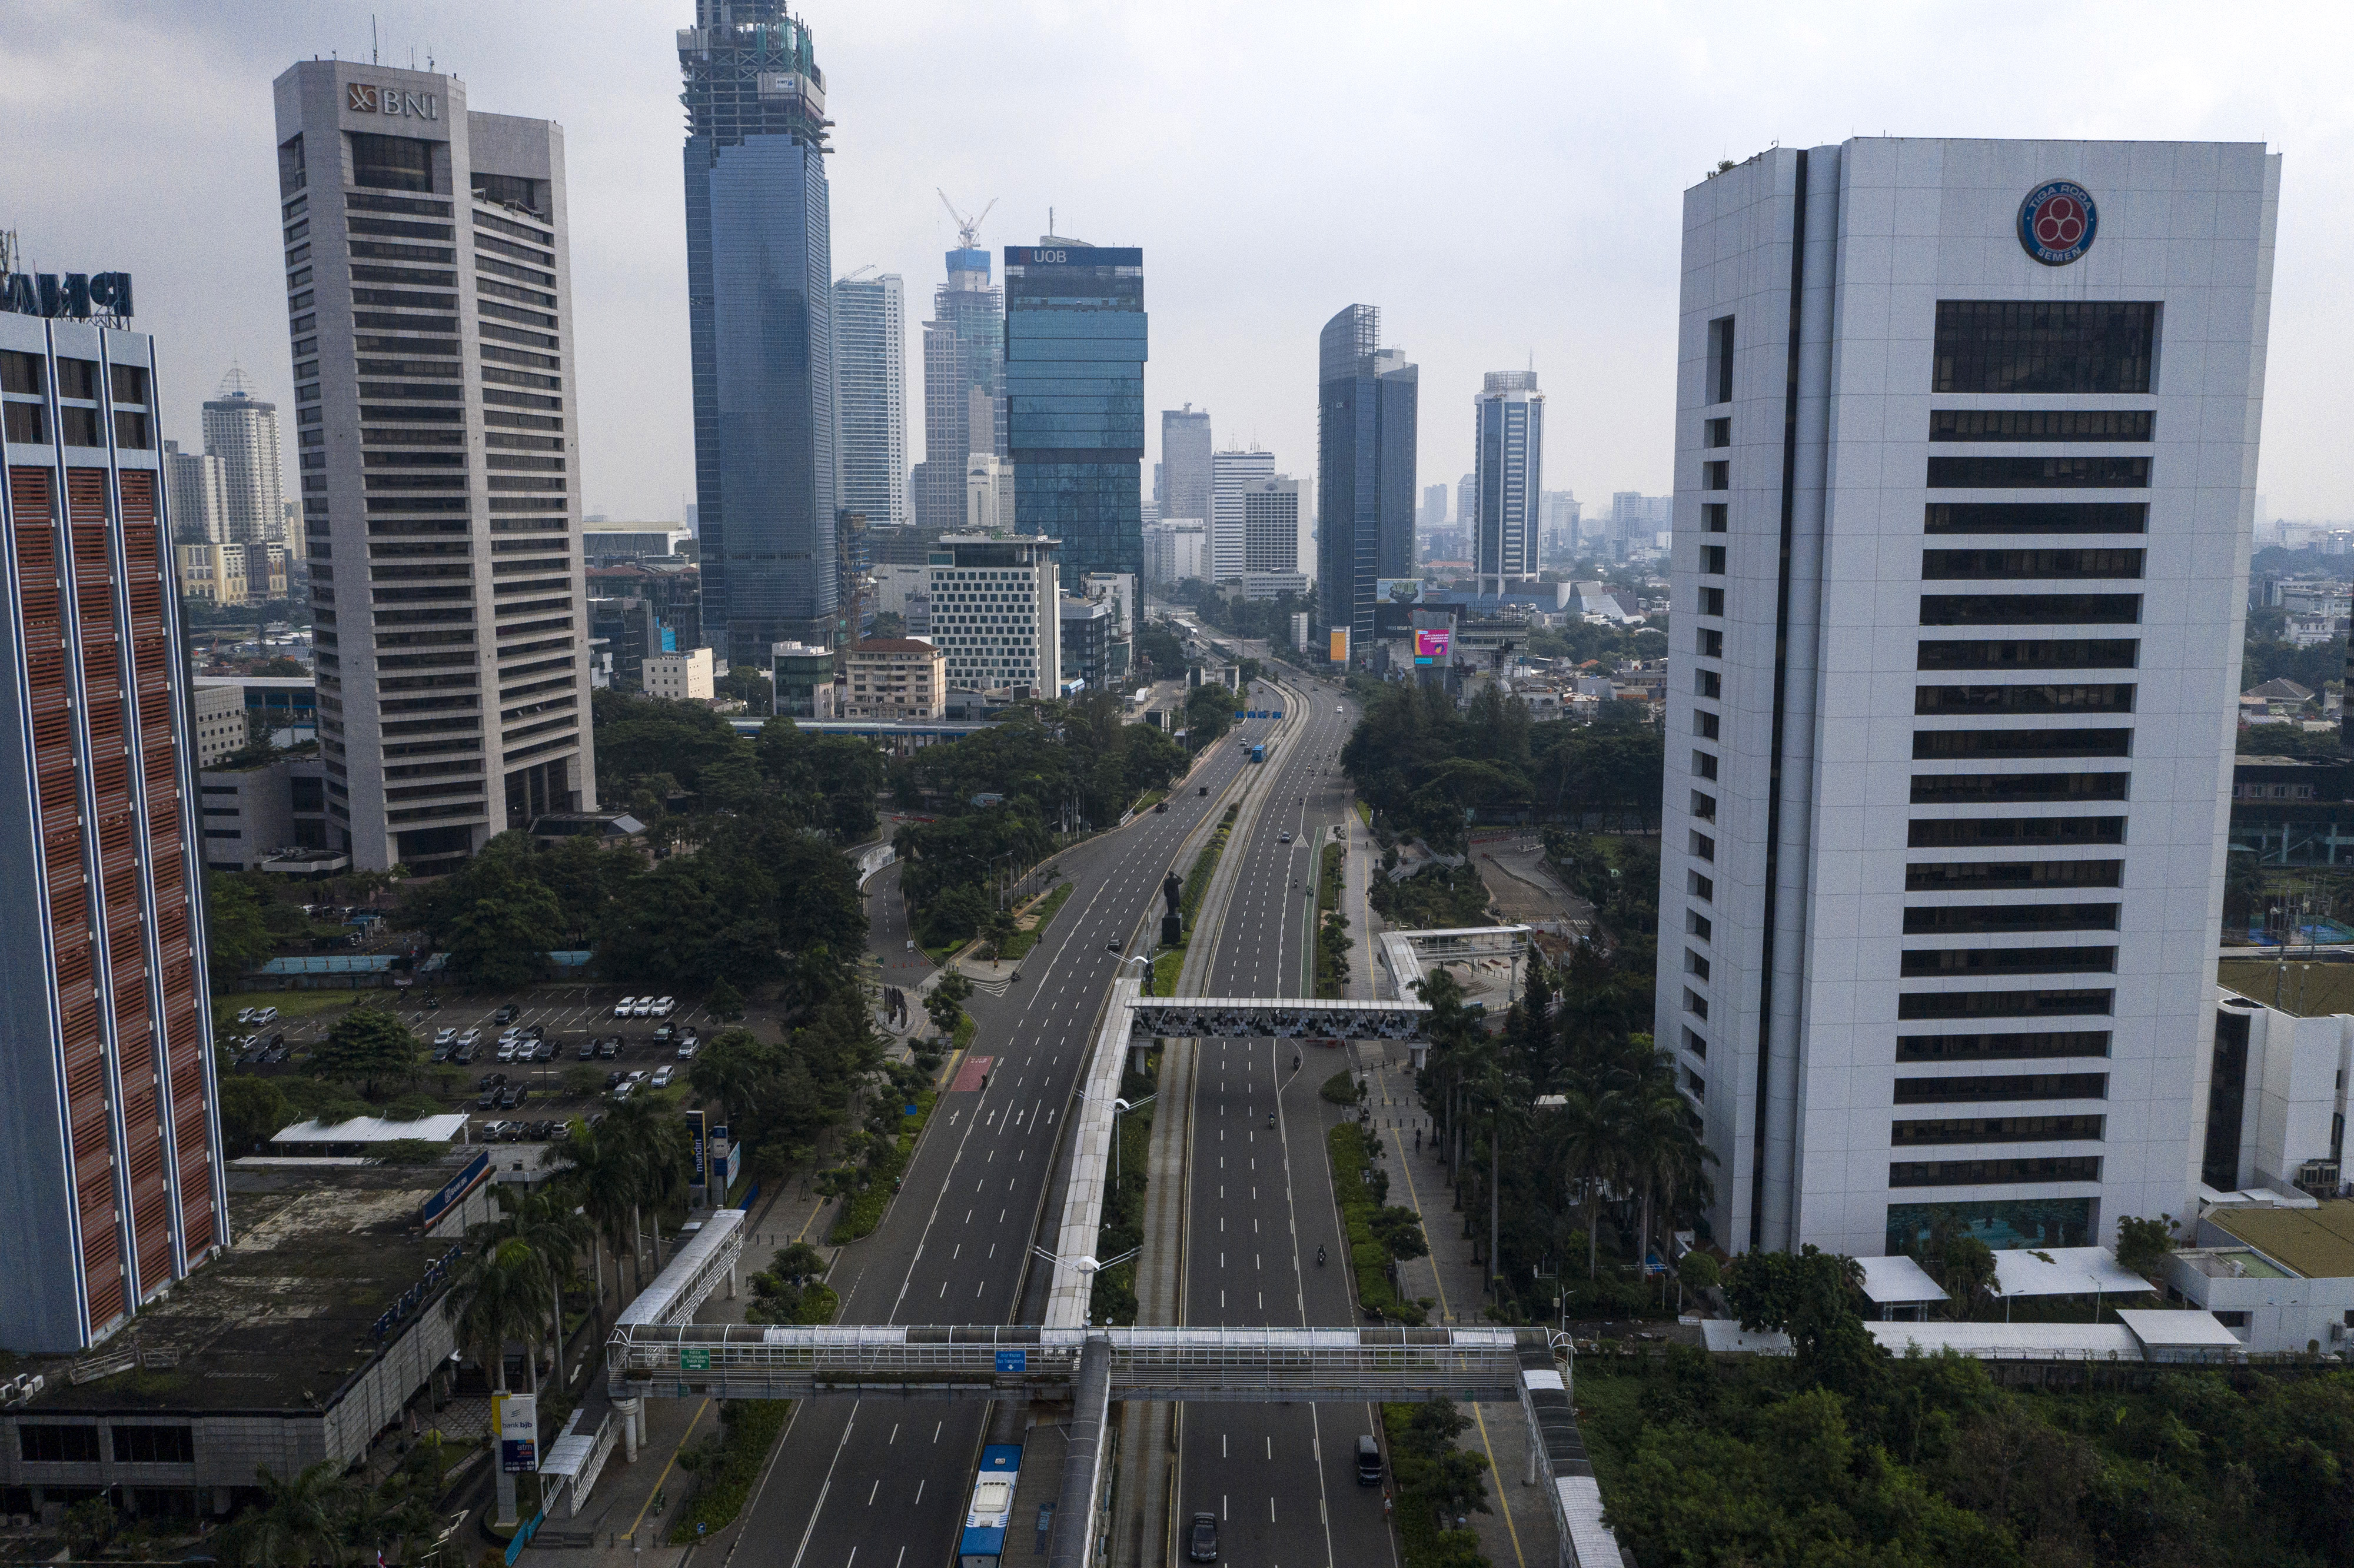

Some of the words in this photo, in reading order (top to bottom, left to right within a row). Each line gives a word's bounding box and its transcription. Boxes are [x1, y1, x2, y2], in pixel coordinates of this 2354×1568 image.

[383, 89, 438, 121] BNI
[2029, 186, 2057, 209] TIGA
[2060, 184, 2093, 211] RODA
[1034, 249, 1066, 263] UOB
[2037, 246, 2082, 261] SEMEN
